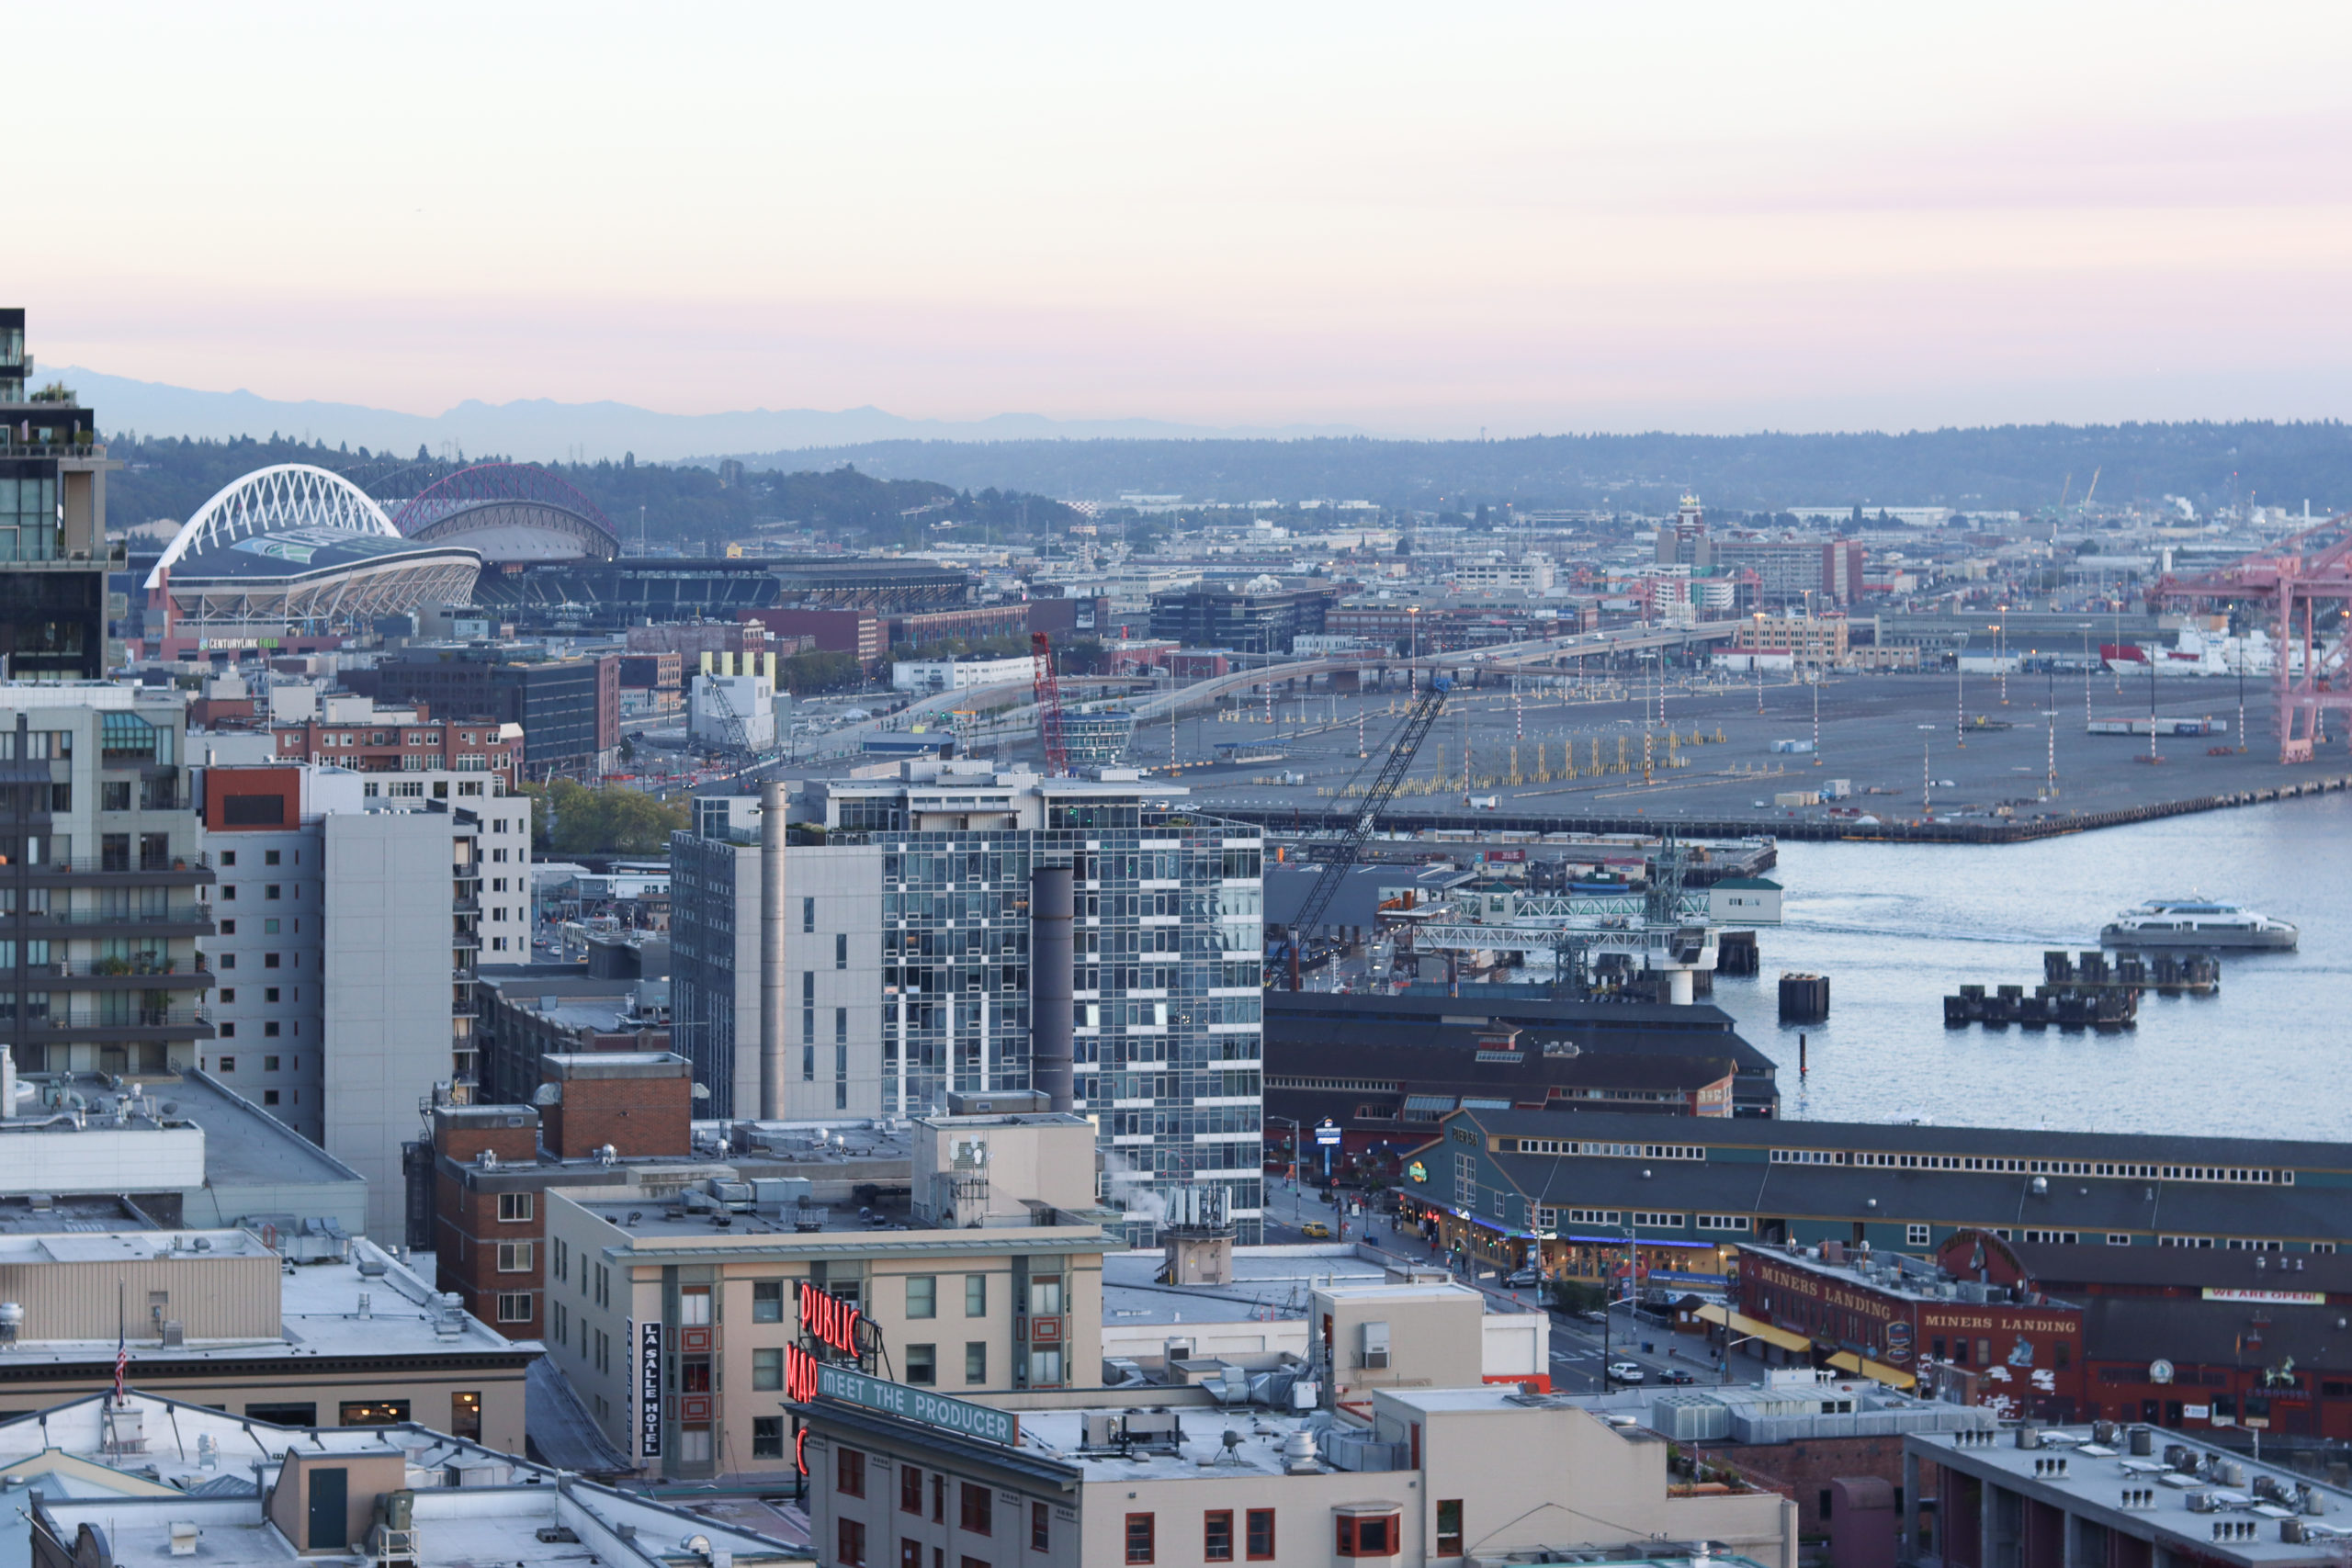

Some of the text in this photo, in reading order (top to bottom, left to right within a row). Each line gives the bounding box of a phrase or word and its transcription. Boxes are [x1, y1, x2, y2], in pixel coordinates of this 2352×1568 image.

[258, 637, 278, 649] FIELD
[1453, 1126, 1468, 1145] PIER
[1761, 1266, 1891, 1320] MINERS LANDING
[2212, 1288, 2316, 1301] WE ARE OPEN!
[800, 1282, 859, 1358] PUBLIC
[1926, 1314, 2076, 1333] MINERS LANDING
[645, 1325, 658, 1453] LA SALLE HOTEL
[823, 1371, 1008, 1438] MEET THE PRODUCER
